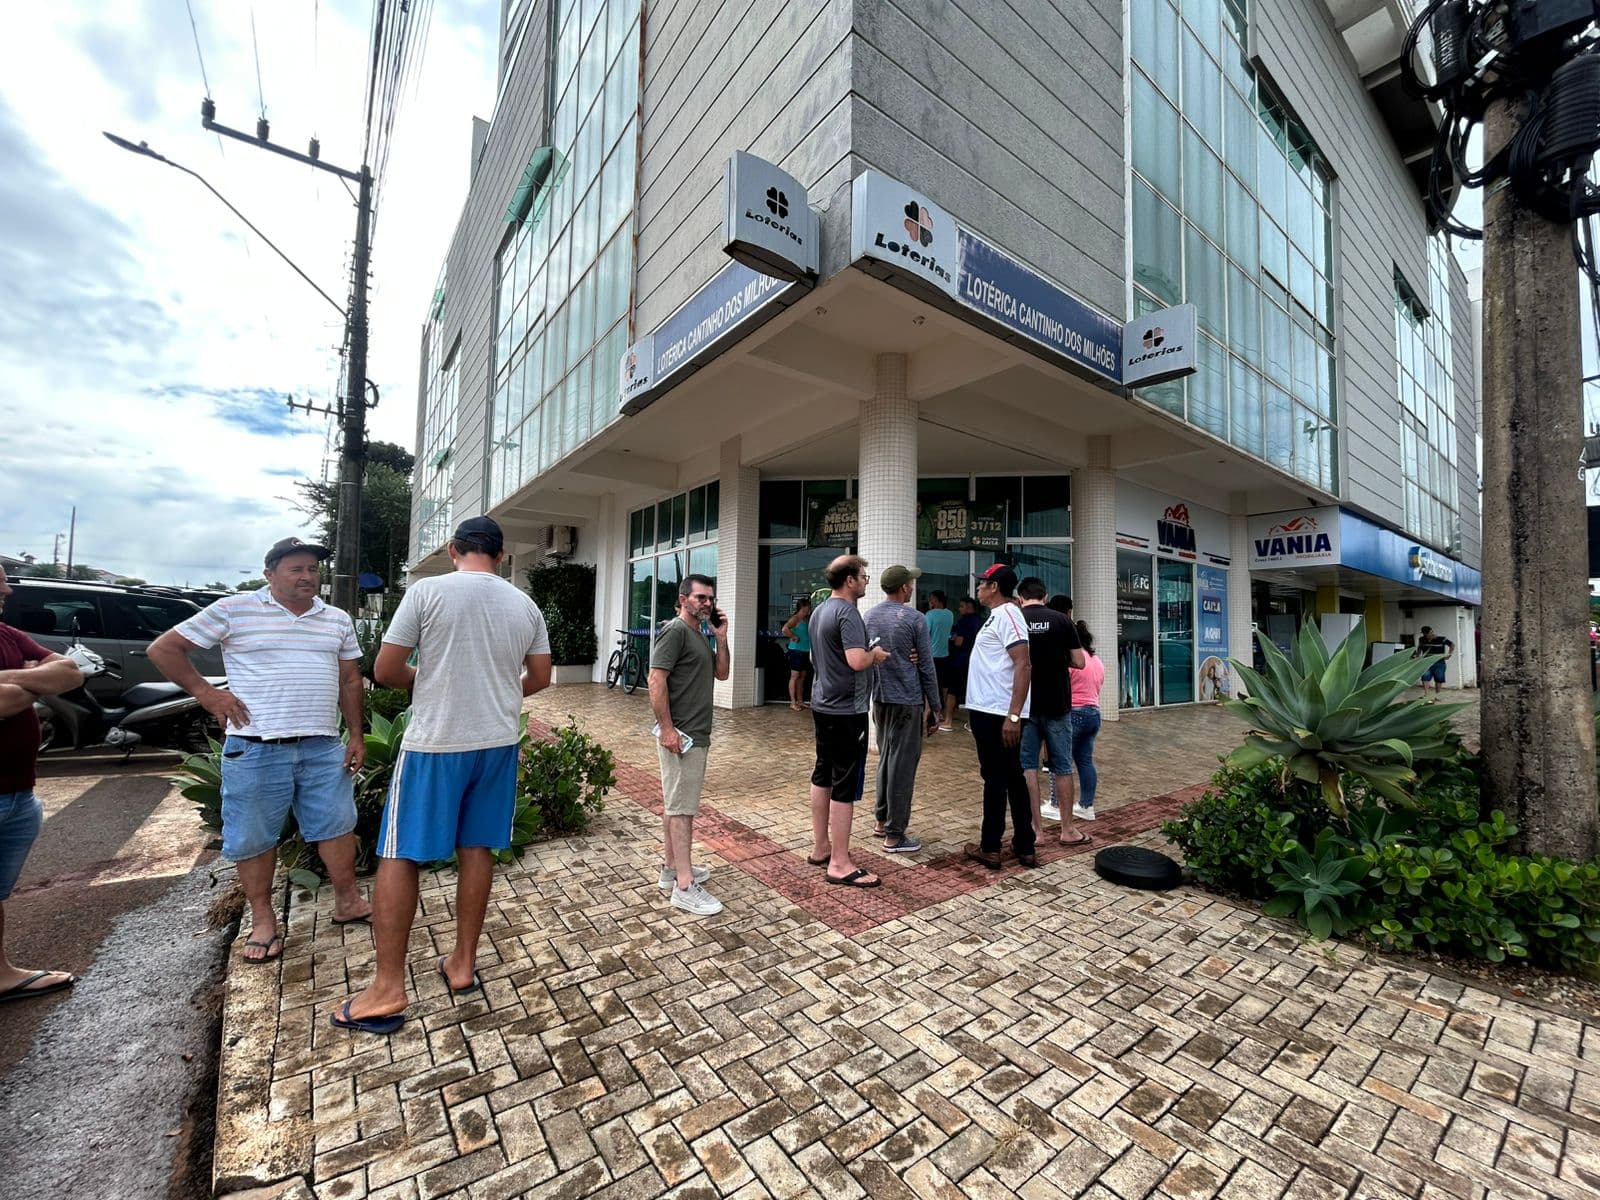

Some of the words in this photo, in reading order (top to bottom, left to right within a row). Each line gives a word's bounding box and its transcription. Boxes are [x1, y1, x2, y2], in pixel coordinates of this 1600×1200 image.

[745, 207, 803, 246] Loterias
[874, 231, 952, 285] Loterias
[656, 335, 688, 372] LOTÉRICA
[687, 311, 723, 354] CANTINHO
[723, 290, 743, 323] DOS
[966, 275, 1018, 320] LOTÉRICA
[1018, 301, 1063, 345] CANTINHO
[1064, 326, 1083, 352] DOS
[1083, 336, 1116, 372] MILHÕES
[1128, 343, 1184, 367] Loterias
[824, 508, 858, 524] MEGA
[937, 508, 968, 530] 850
[970, 520, 1002, 532] 31/12
[1254, 533, 1332, 558] VANIA
